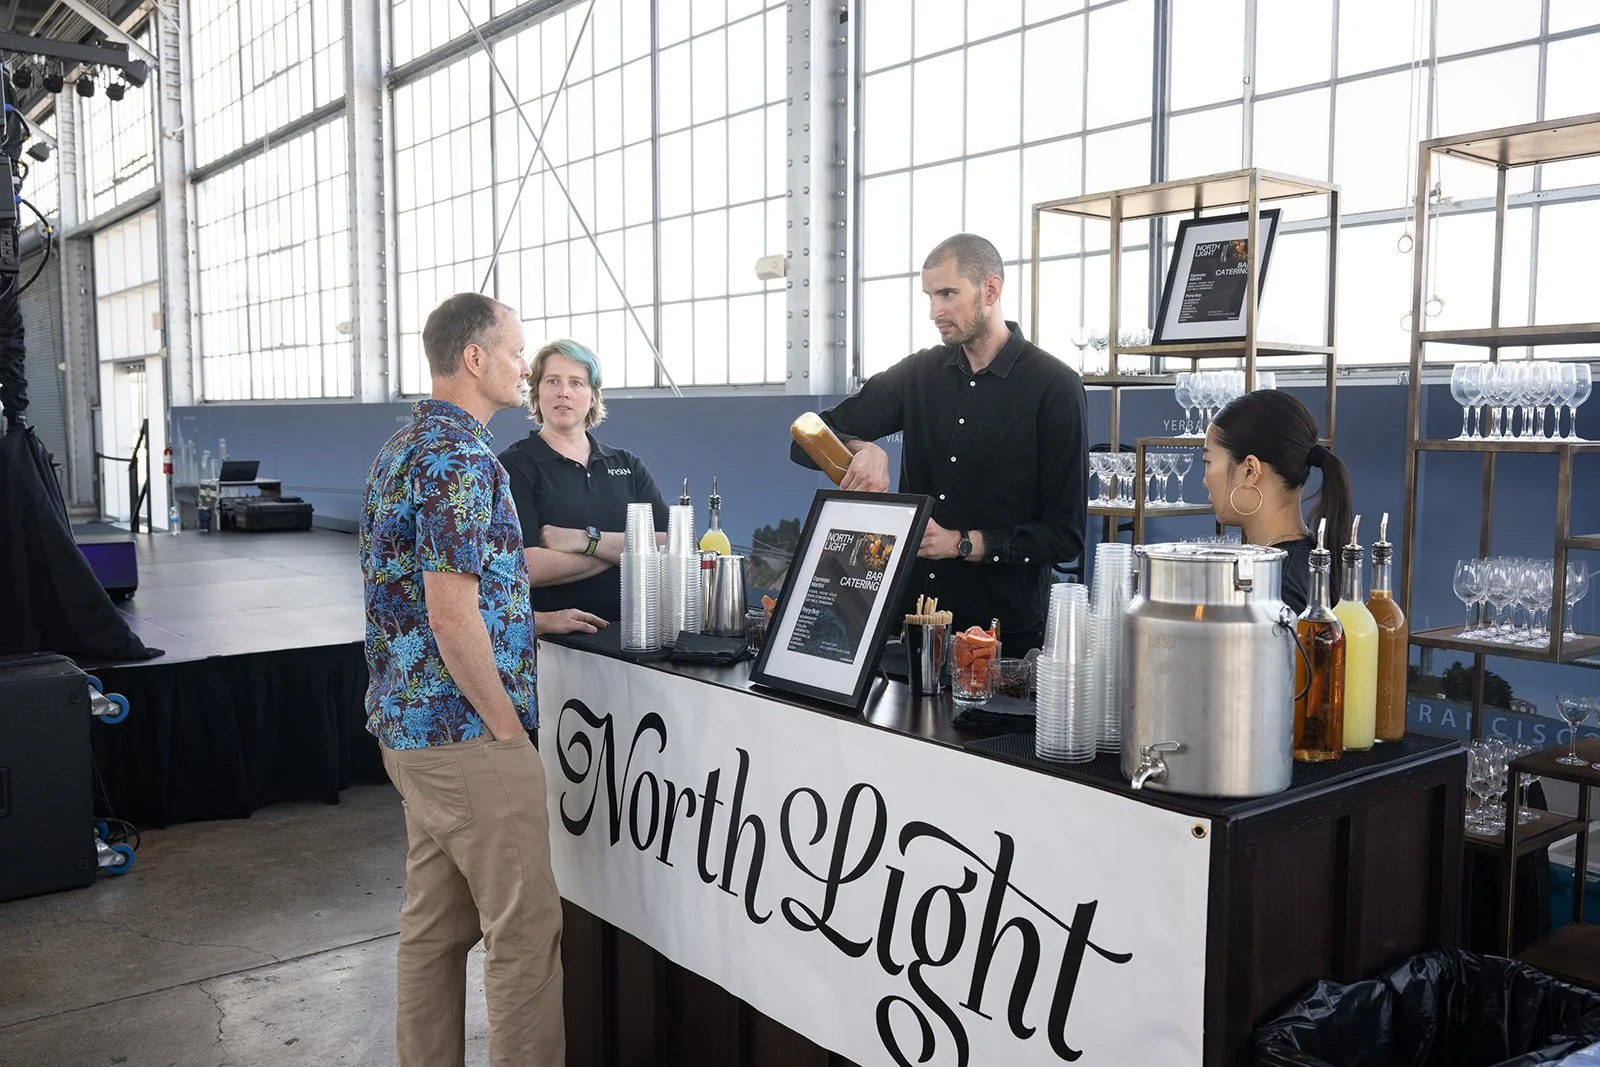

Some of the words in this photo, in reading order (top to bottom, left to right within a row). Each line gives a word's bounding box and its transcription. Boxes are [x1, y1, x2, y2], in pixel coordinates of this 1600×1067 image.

[1196, 243, 1220, 251] NORTH
[1195, 249, 1215, 257] LIGHT
[1237, 261, 1248, 269] BA
[827, 532, 855, 544] NORTH
[824, 540, 847, 552] LIGHT
[865, 570, 884, 581] BAR
[840, 576, 880, 592] CATERING
[556, 698, 773, 925] North
[779, 782, 1133, 1067] Light
